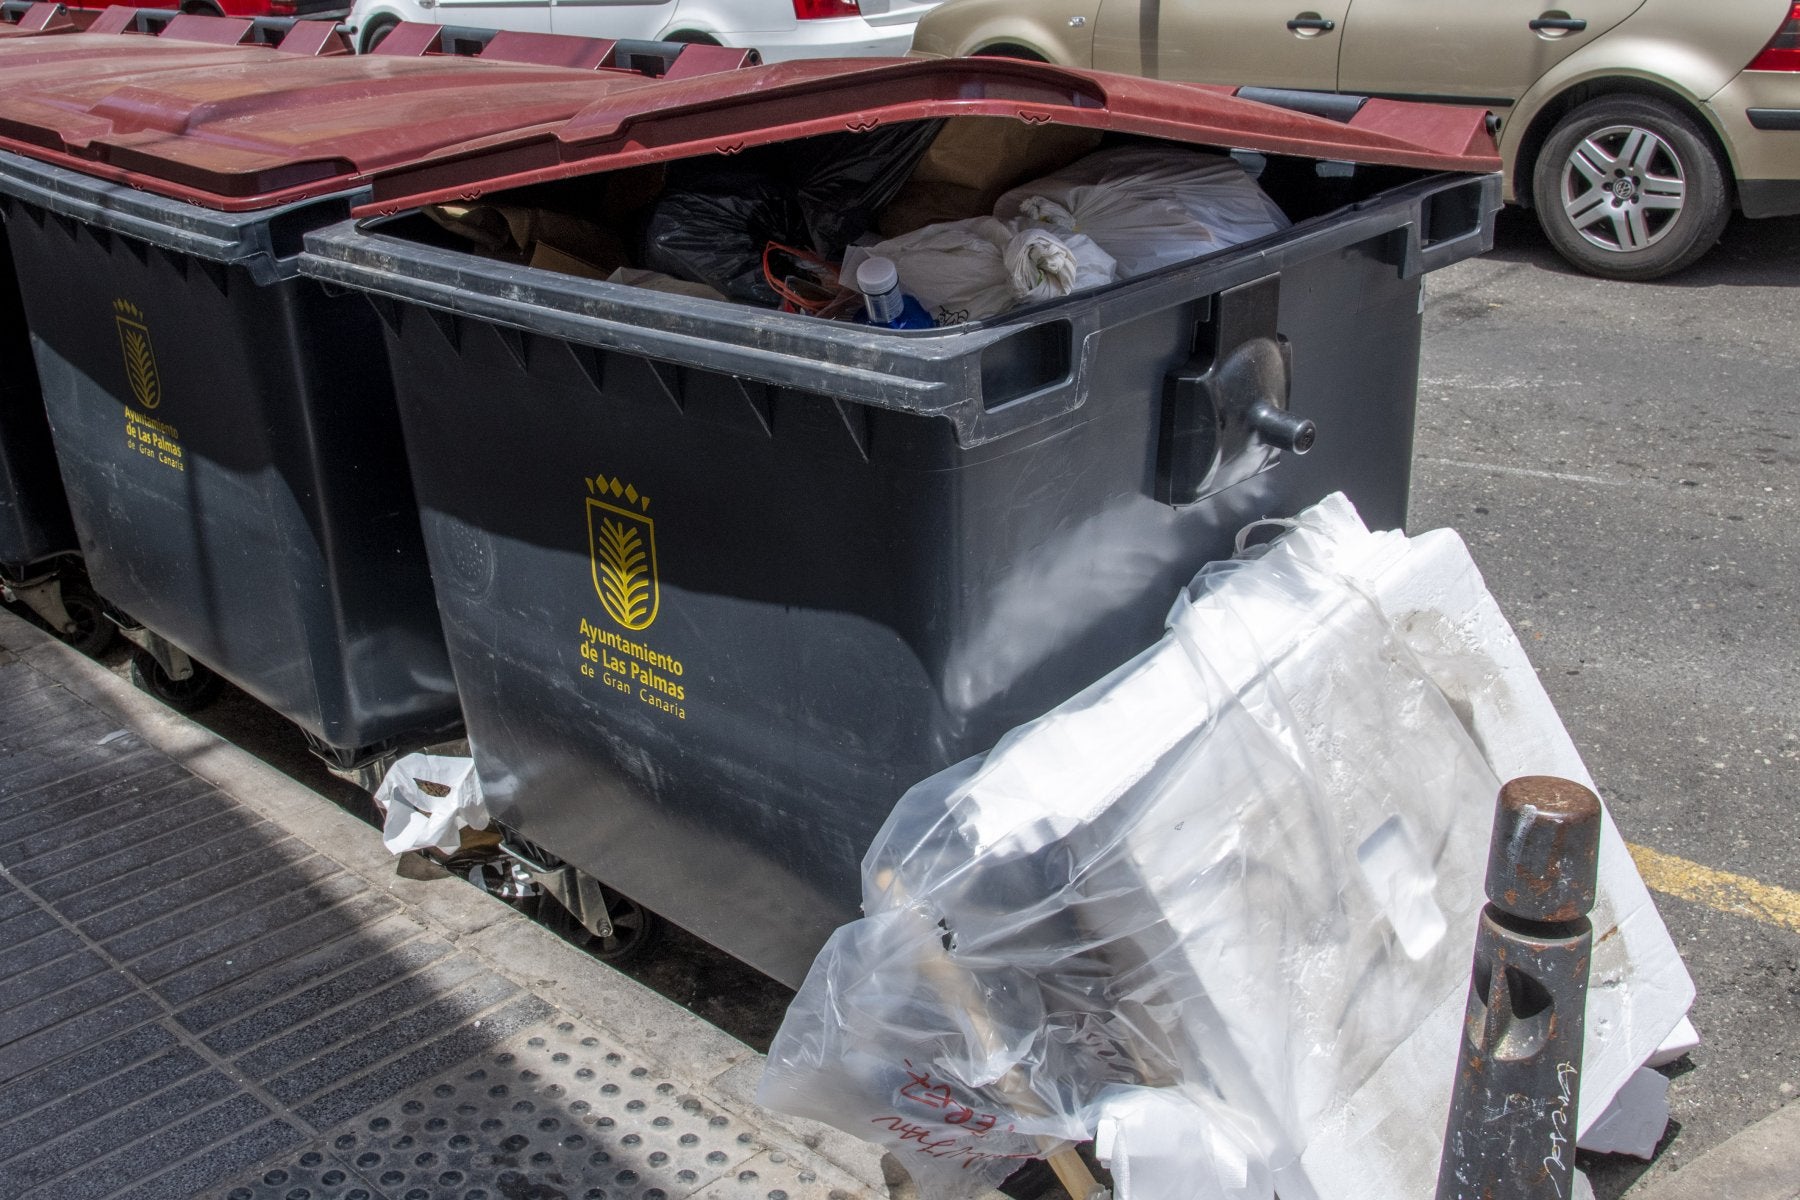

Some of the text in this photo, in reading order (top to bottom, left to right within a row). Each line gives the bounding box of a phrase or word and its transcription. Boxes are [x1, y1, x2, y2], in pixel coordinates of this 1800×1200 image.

[125, 405, 178, 439] Ayuntamiento
[126, 421, 182, 458] de Las Palmas
[127, 439, 184, 472] de Gran Canaria
[580, 617, 683, 676] Ayuntamiento
[580, 640, 685, 700] de Las Palmas
[580, 662, 685, 720] de Gran Canaria
